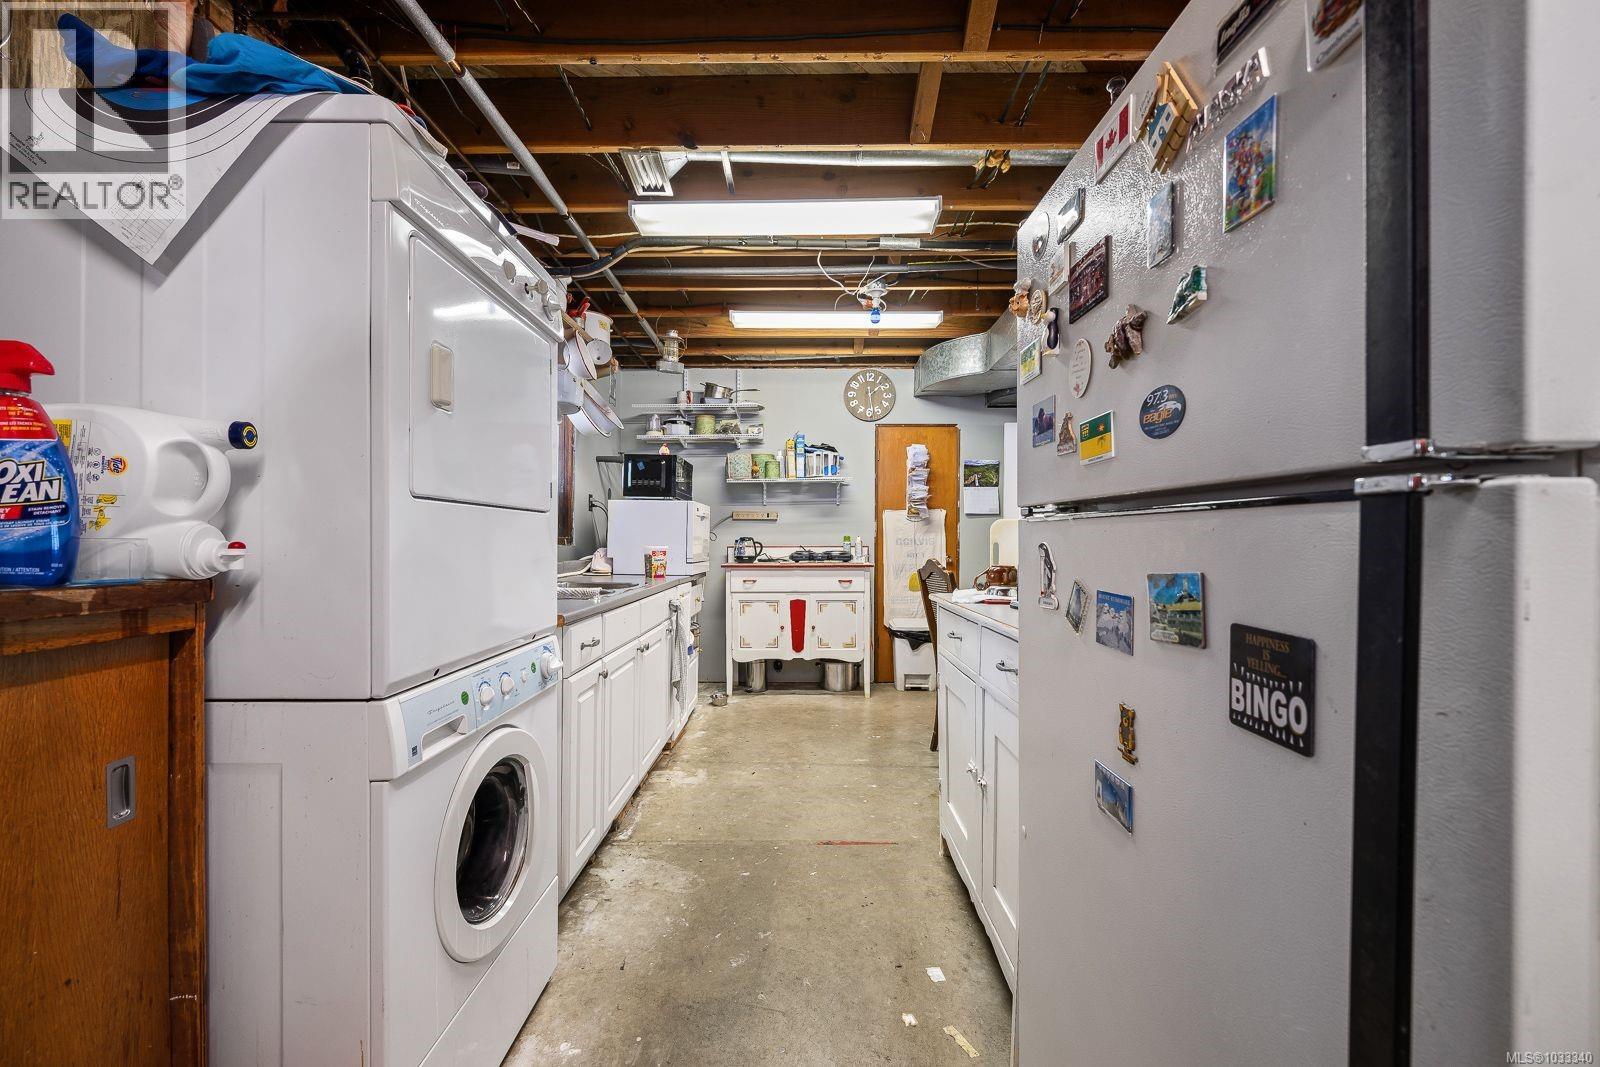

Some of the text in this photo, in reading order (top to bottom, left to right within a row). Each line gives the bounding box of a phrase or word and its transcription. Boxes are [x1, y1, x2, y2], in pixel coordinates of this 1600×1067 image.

[857, 374, 866, 383] 11
[867, 373, 875, 381] 12
[876, 375, 882, 384] 1
[850, 380, 860, 390] 10
[880, 383, 890, 391] 2
[849, 399, 859, 407] 8
[1146, 389, 1169, 407] 97.3
[881, 400, 890, 408] 4
[874, 405, 882, 415] 5
[1143, 408, 1172, 424] eagle
[111, 457, 123, 474] Tide
[1246, 633, 1290, 653] HAPPINESS
[1262, 648, 1271, 661] IS
[1231, 677, 1308, 735] BINGO
